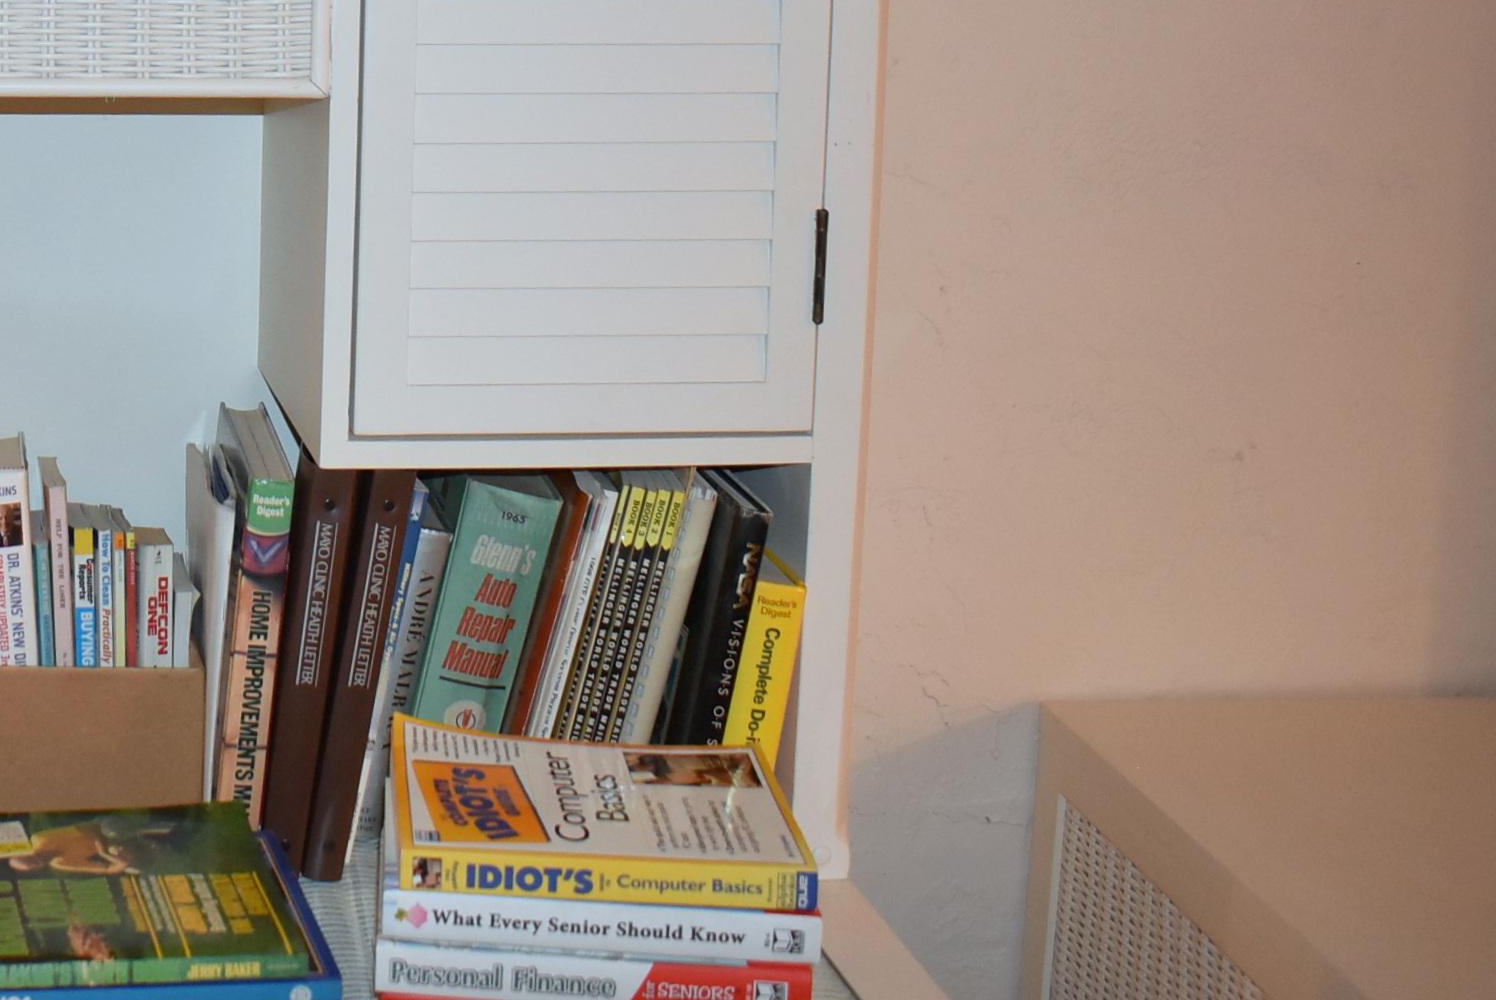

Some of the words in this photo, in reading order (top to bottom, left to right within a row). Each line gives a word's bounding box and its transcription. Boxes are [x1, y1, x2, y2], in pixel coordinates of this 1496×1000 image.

[253, 493, 290, 507] Reader's
[257, 505, 284, 519] Digest
[628, 499, 641, 526] BOOK
[642, 501, 653, 529] BOOK
[653, 499, 666, 526] BOOK
[669, 501, 681, 528] BOOK
[101, 533, 110, 557] How
[318, 523, 334, 558] MAYO
[375, 525, 393, 562] MAYO
[470, 534, 537, 577] Glenn's
[7, 553, 21, 573] DR.
[78, 564, 87, 600] Reports
[102, 561, 110, 573] To
[312, 560, 329, 602] CLINIC
[368, 562, 388, 602] CLINIC
[102, 575, 112, 606] Clean
[406, 568, 435, 642] ANDRÉ
[473, 573, 518, 609] Auto
[601, 558, 625, 625] MELLINGER
[613, 561, 637, 627] MELLINGER
[626, 558, 651, 625] MELLINGER
[641, 561, 665, 633] MELLINGER
[757, 594, 797, 610] Reader's
[147, 596, 158, 637] ONE
[157, 576, 169, 655] DEFCON
[248, 591, 273, 642] HOME
[307, 600, 323, 647] HEALTH
[362, 602, 379, 648] HEALTH
[456, 605, 516, 645] Repair
[760, 606, 791, 619] Digest
[11, 621, 25, 649] NEW
[80, 610, 95, 667] BUYING
[101, 608, 112, 665] Practically
[589, 629, 606, 668] WORLD
[602, 632, 619, 671] WORLD
[615, 629, 632, 669] WORLD
[630, 632, 646, 672] WORLD
[301, 647, 318, 686] LETTER
[354, 648, 369, 687] LETTER
[441, 640, 509, 680] Manual
[753, 627, 781, 705] Complete
[578, 673, 595, 710] TRADE
[590, 676, 606, 713] TRADE
[603, 673, 619, 710] TRADE
[618, 677, 634, 713] TRADE
[234, 644, 268, 781] IMPROVEMENTS
[434, 777, 468, 826] COMPLETE
[451, 766, 520, 840] IDIOT'S
[546, 751, 590, 842] Computer
[591, 774, 631, 823] Basics
[465, 863, 594, 894] IDIOT'S
[616, 874, 705, 895] Computer
[711, 877, 763, 896] Basics
[432, 908, 483, 929] What
[488, 911, 542, 937] Every
[548, 914, 610, 938] Senior
[615, 919, 683, 942] Should
[687, 924, 746, 946] Know
[188, 963, 223, 979] JERRY
[225, 961, 261, 978] BAKER
[389, 959, 503, 991] Personal
[511, 966, 617, 998] Finance
[657, 983, 735, 1000] SENIORS
